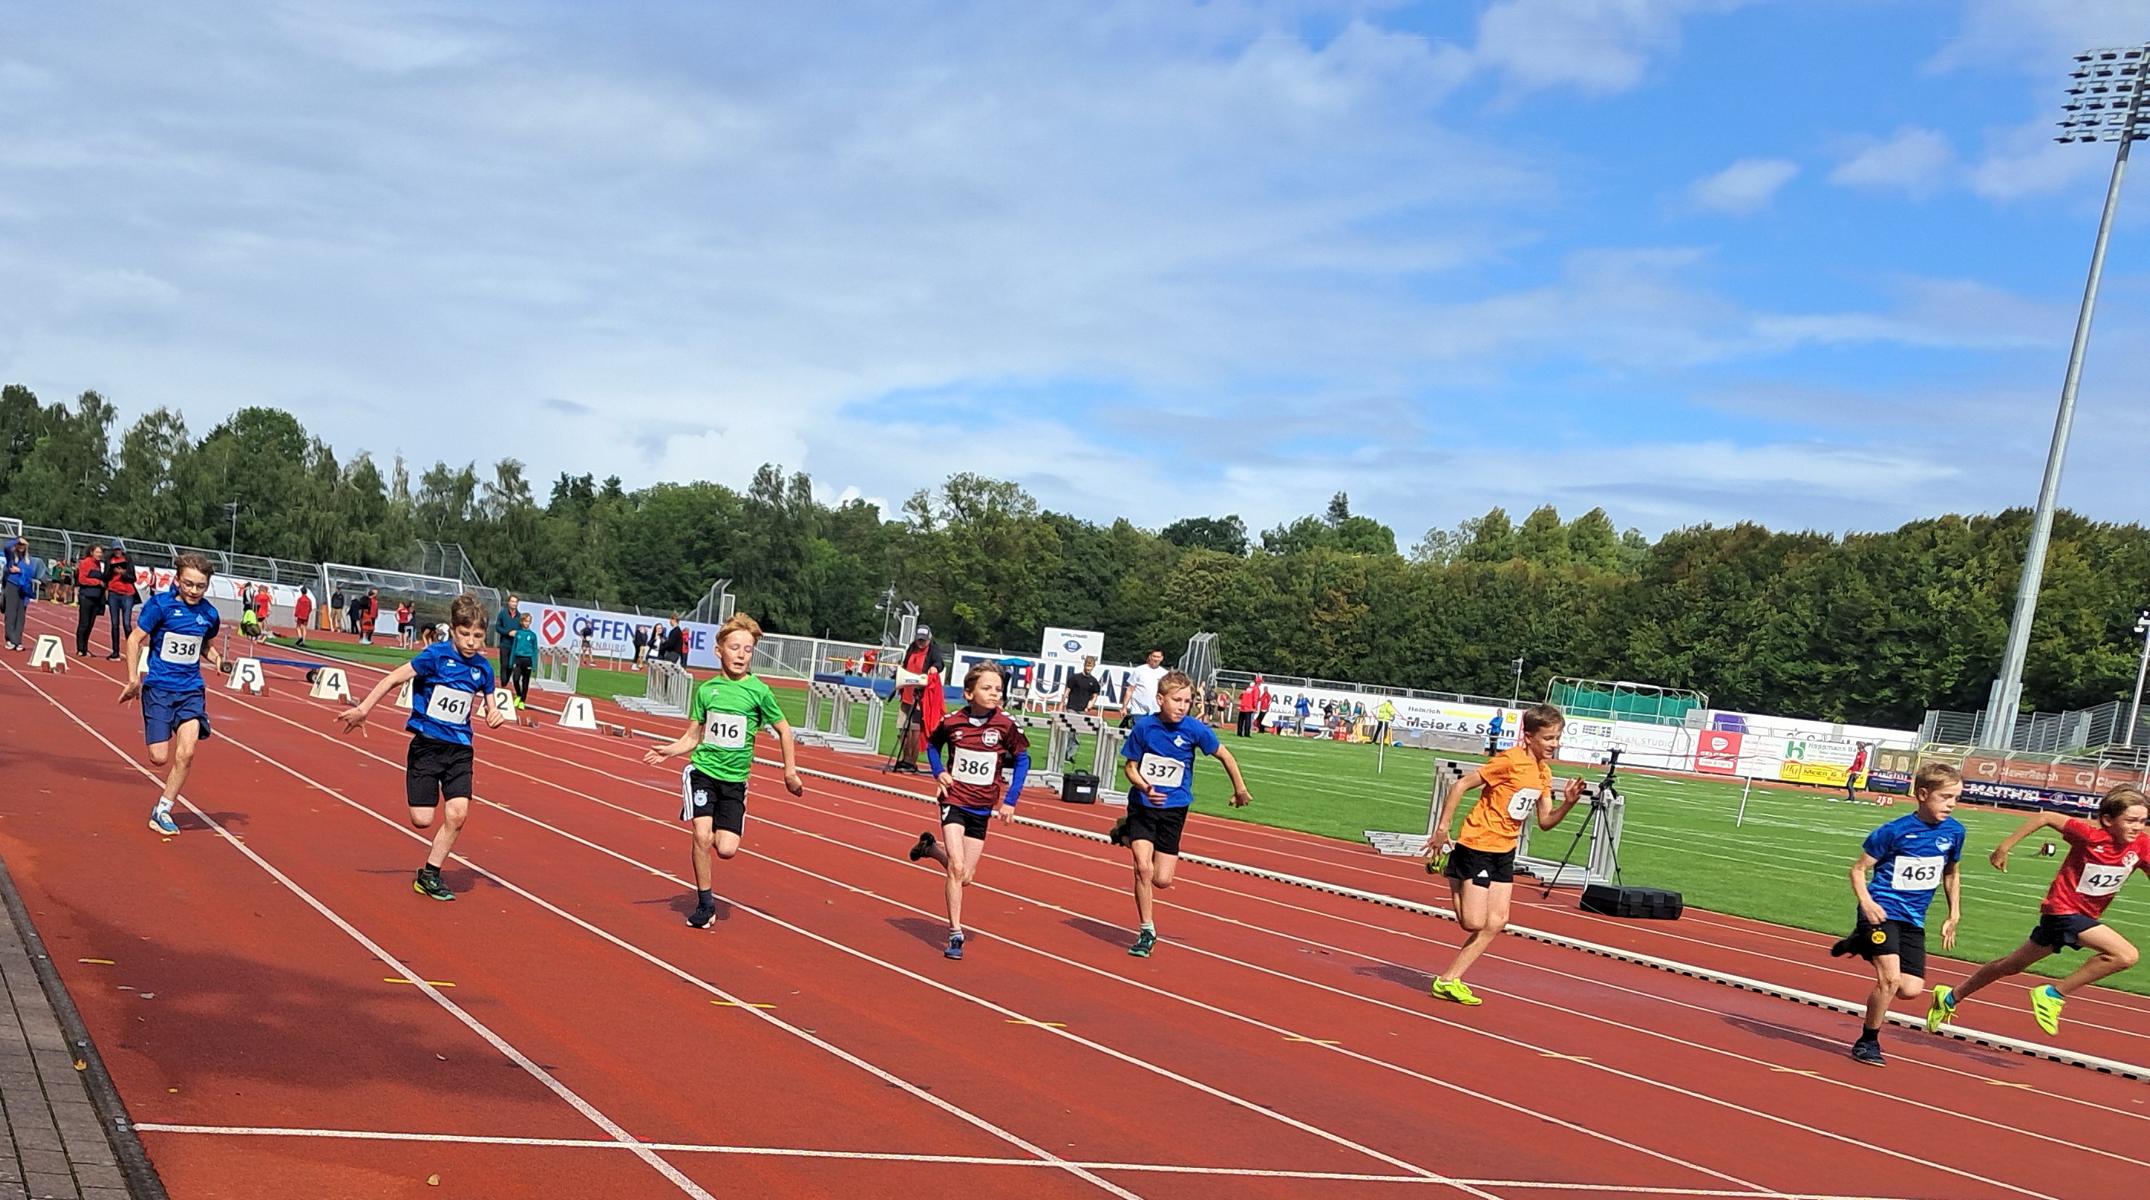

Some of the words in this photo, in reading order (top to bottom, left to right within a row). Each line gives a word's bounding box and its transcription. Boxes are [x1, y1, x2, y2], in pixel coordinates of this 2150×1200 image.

[43, 638, 58, 658] 7
[168, 641, 196, 656] 338
[241, 663, 256, 683] 5
[327, 672, 341, 691] 4
[437, 696, 466, 715] 461
[496, 692, 509, 711] 2
[577, 703, 584, 721] 1
[710, 722, 738, 738] 416
[1457, 721, 1468, 733] &
[958, 758, 989, 775] 386
[1146, 763, 1177, 778] 337
[1902, 866, 1936, 881] 463
[2088, 874, 2123, 888] 425
